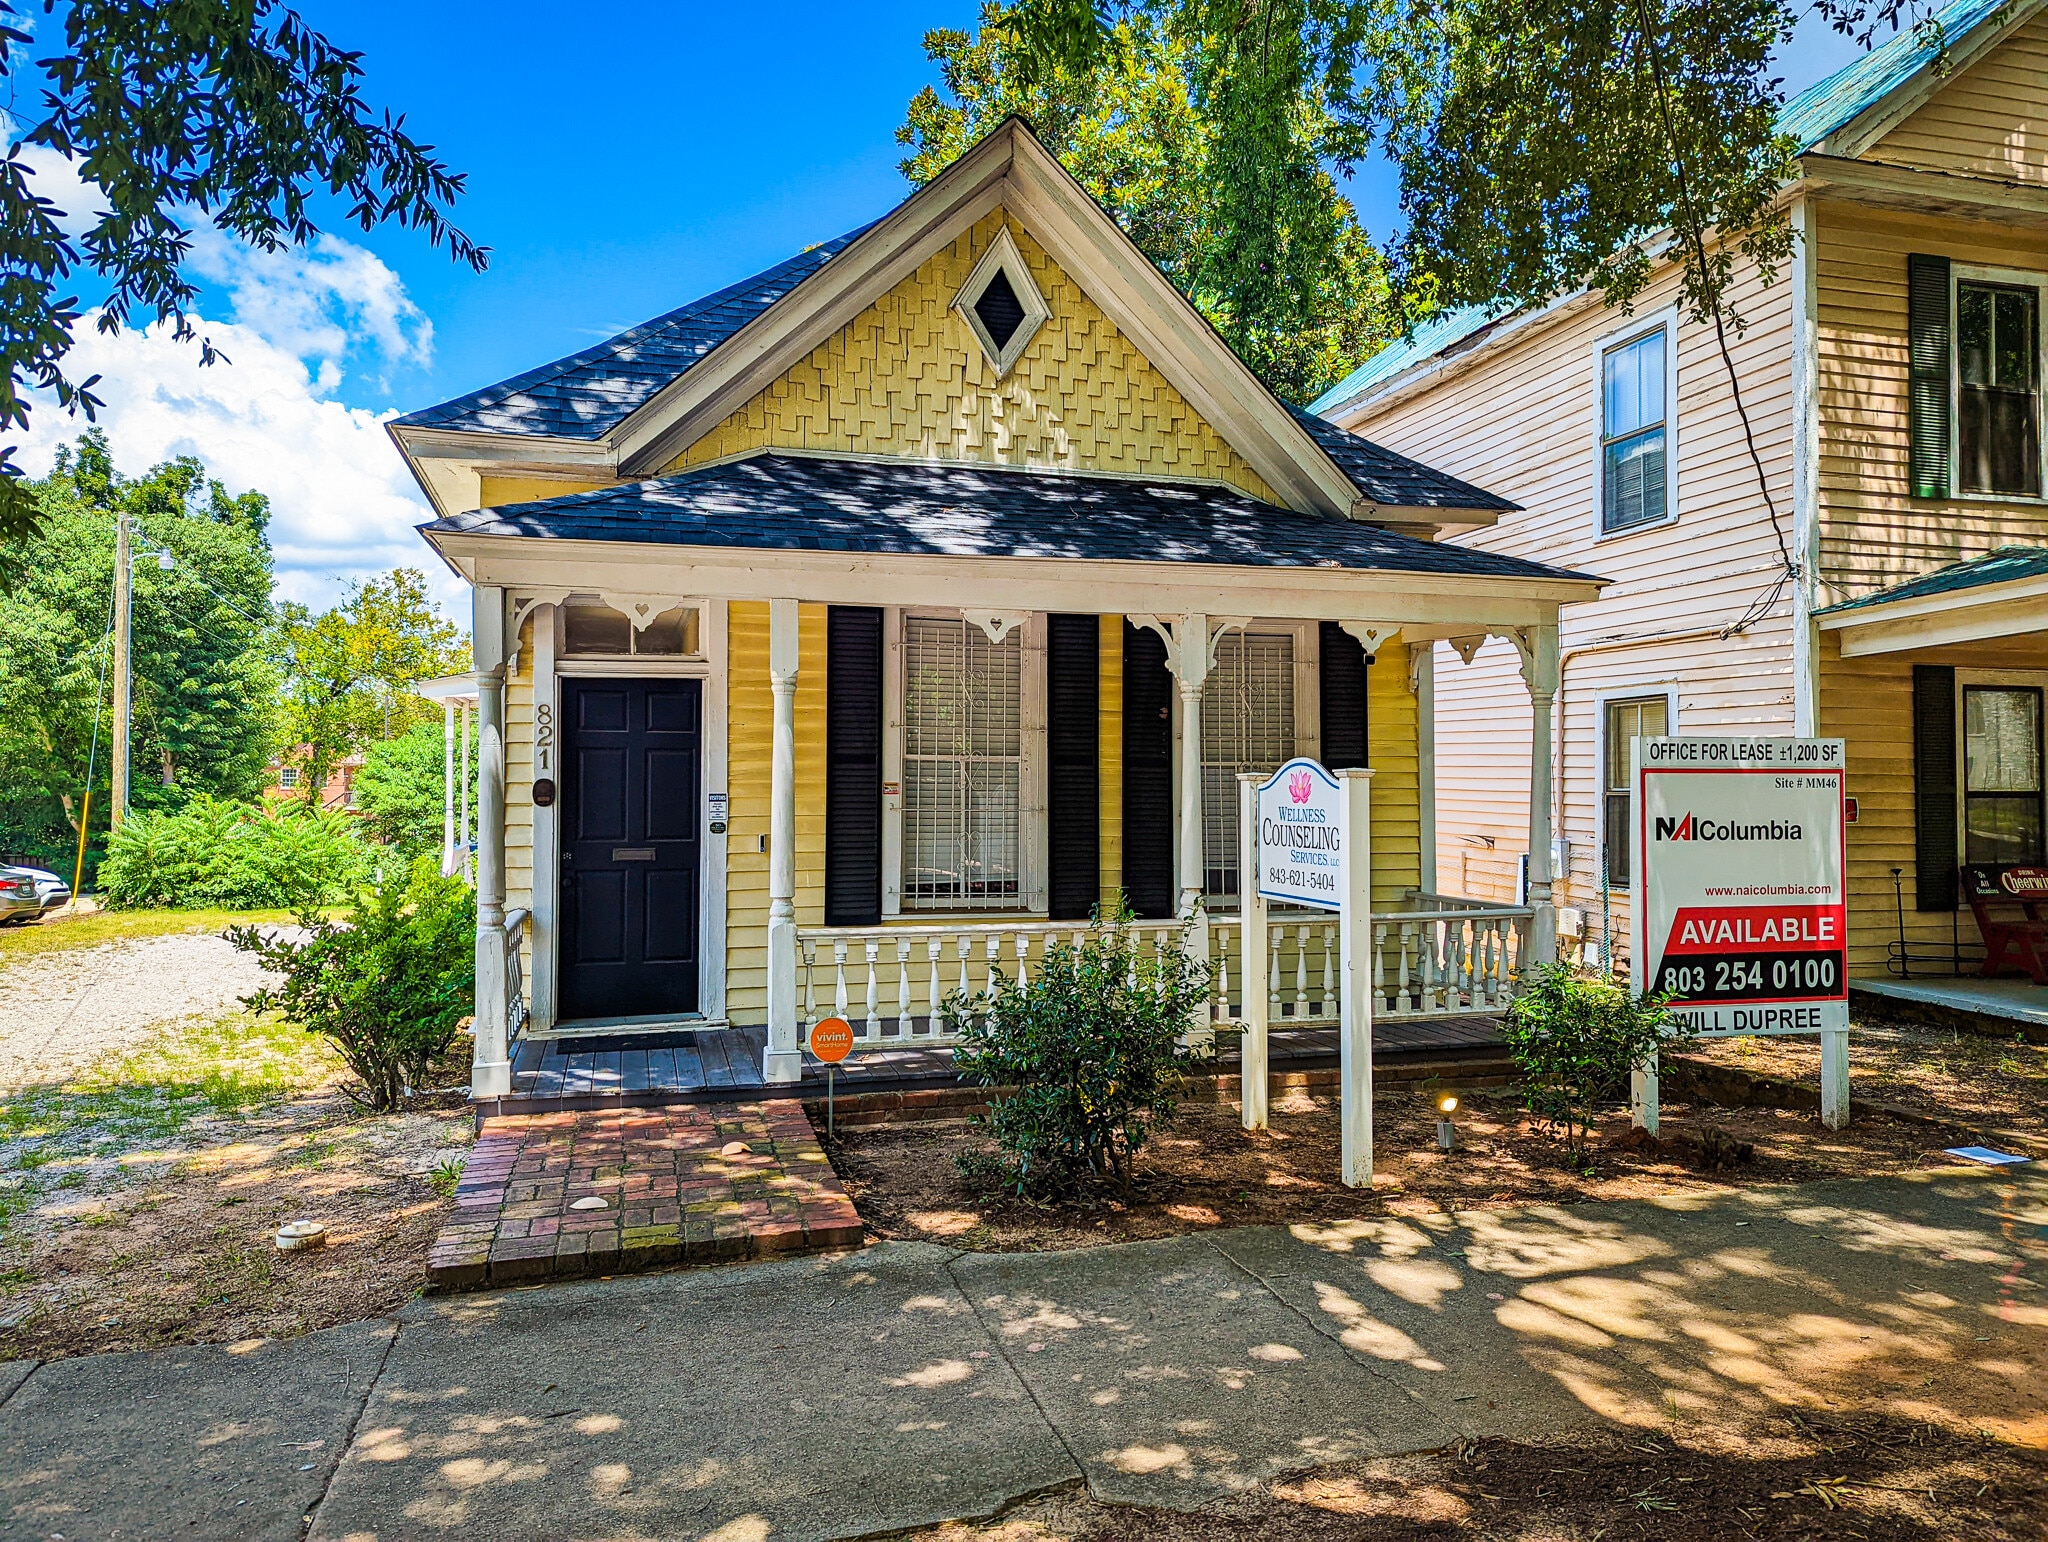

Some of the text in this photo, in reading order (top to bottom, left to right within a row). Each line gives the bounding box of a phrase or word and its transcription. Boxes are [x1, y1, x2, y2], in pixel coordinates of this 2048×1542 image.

[537, 704, 552, 769] 821
[1650, 743, 1838, 763] OFFICE FOR LEASE ±1,200 SF
[1775, 777, 1837, 788] Site # MM46
[1278, 806, 1326, 823] WELLNESS
[1263, 818, 1340, 851] COUNSELING
[1270, 867, 1335, 891] 843-621-5404
[1705, 884, 1832, 896] www.naicolumbia.com
[1680, 917, 1835, 944] AVAILABLE
[1665, 958, 1835, 992] 803 254 0100
[1733, 1007, 1821, 1031] DUPREE
